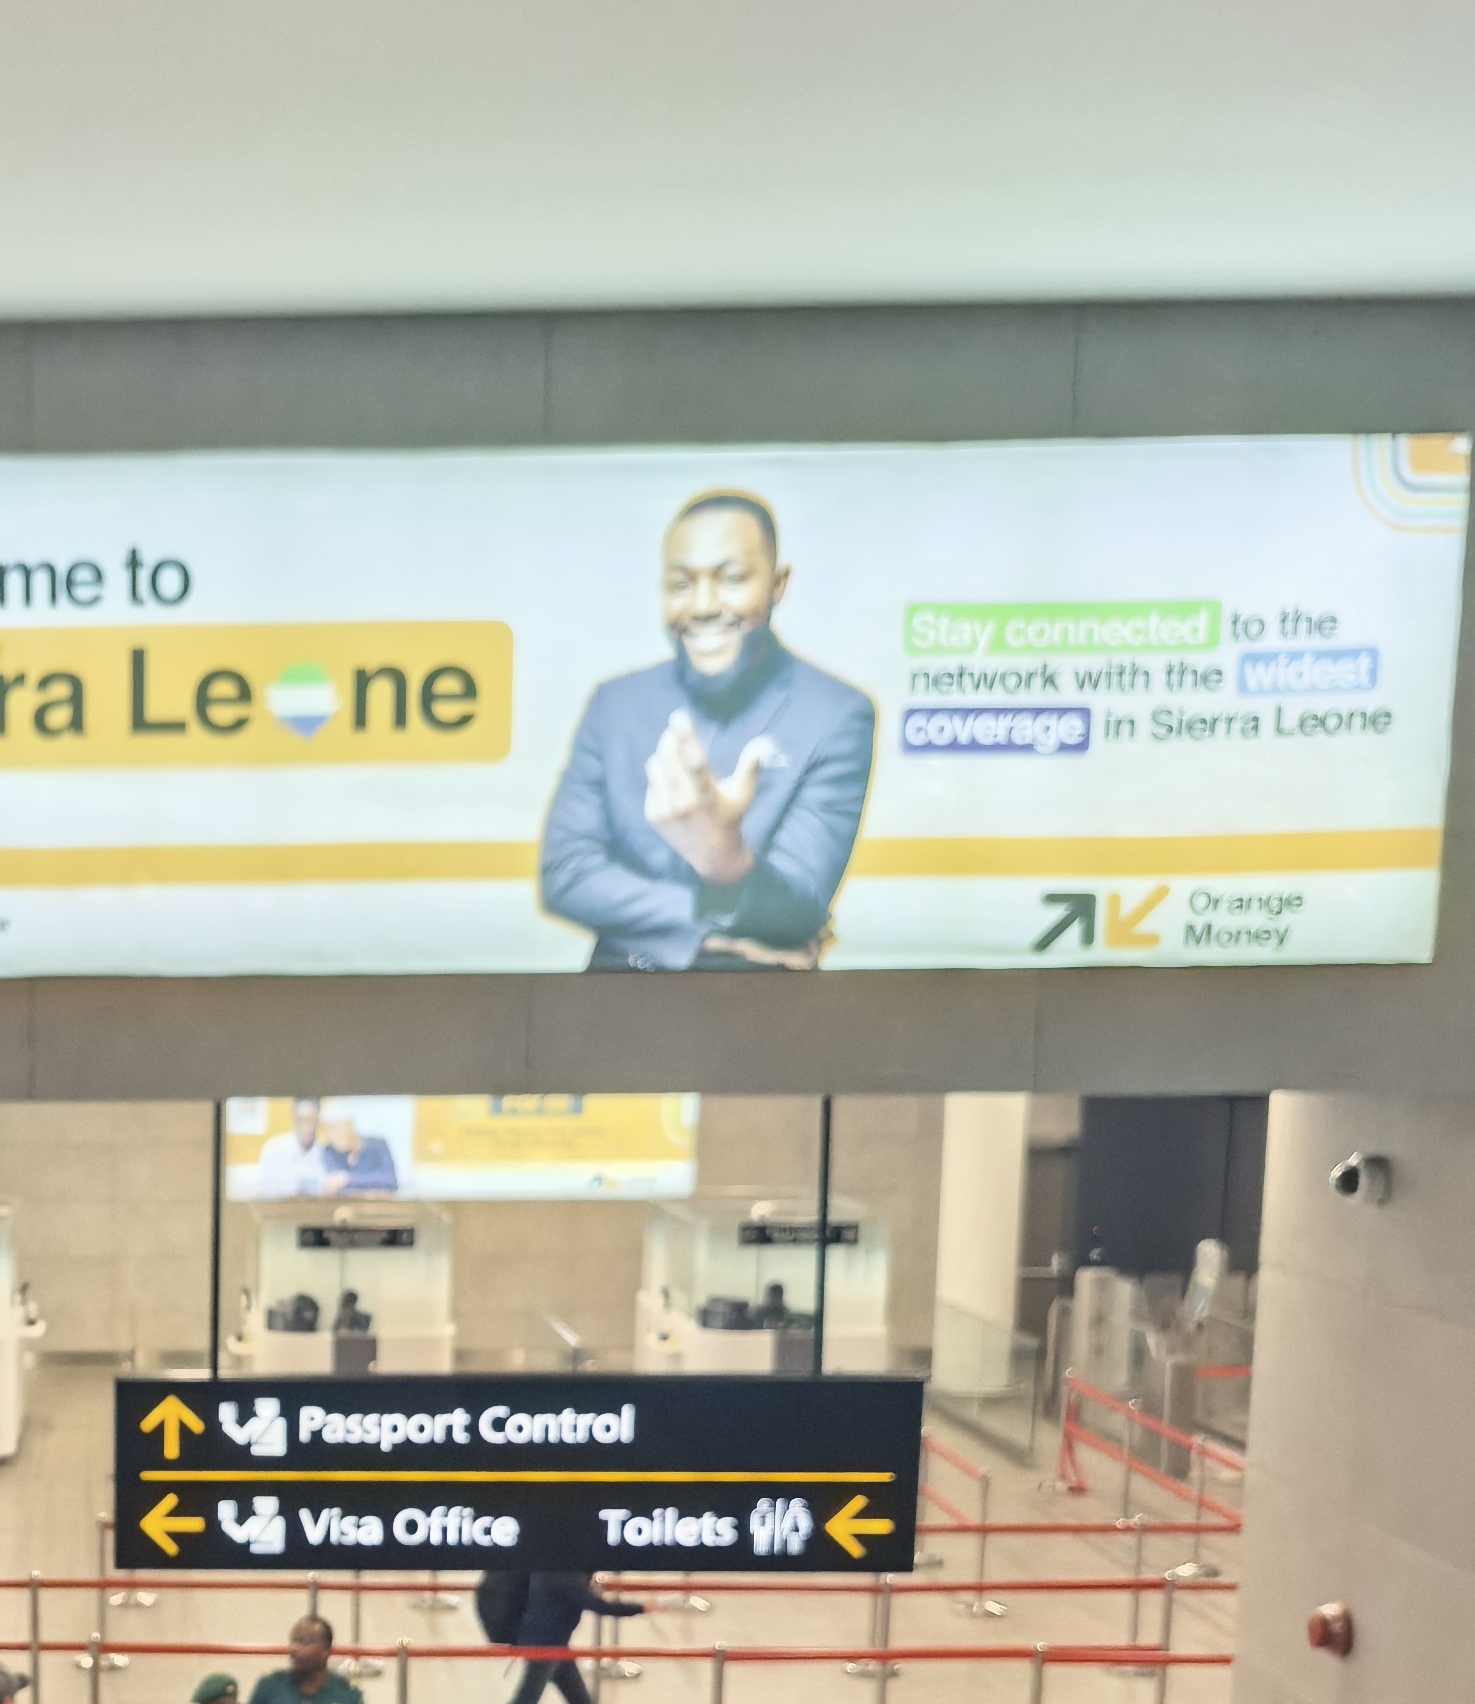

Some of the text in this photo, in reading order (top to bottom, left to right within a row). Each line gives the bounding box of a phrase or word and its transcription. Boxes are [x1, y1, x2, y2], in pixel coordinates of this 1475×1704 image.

[124, 546, 191, 608] to
[910, 607, 1340, 657] Stay connected to the
[128, 647, 478, 738] Lene
[909, 651, 1372, 694] network with the widest
[905, 702, 1393, 754] coverage in Sierra Leone
[1189, 887, 1304, 917] Orange
[1184, 922, 1289, 947] Money
[298, 1403, 635, 1453] Passport Control
[298, 1506, 521, 1546] Visa Office
[599, 1506, 739, 1547] Toilets
